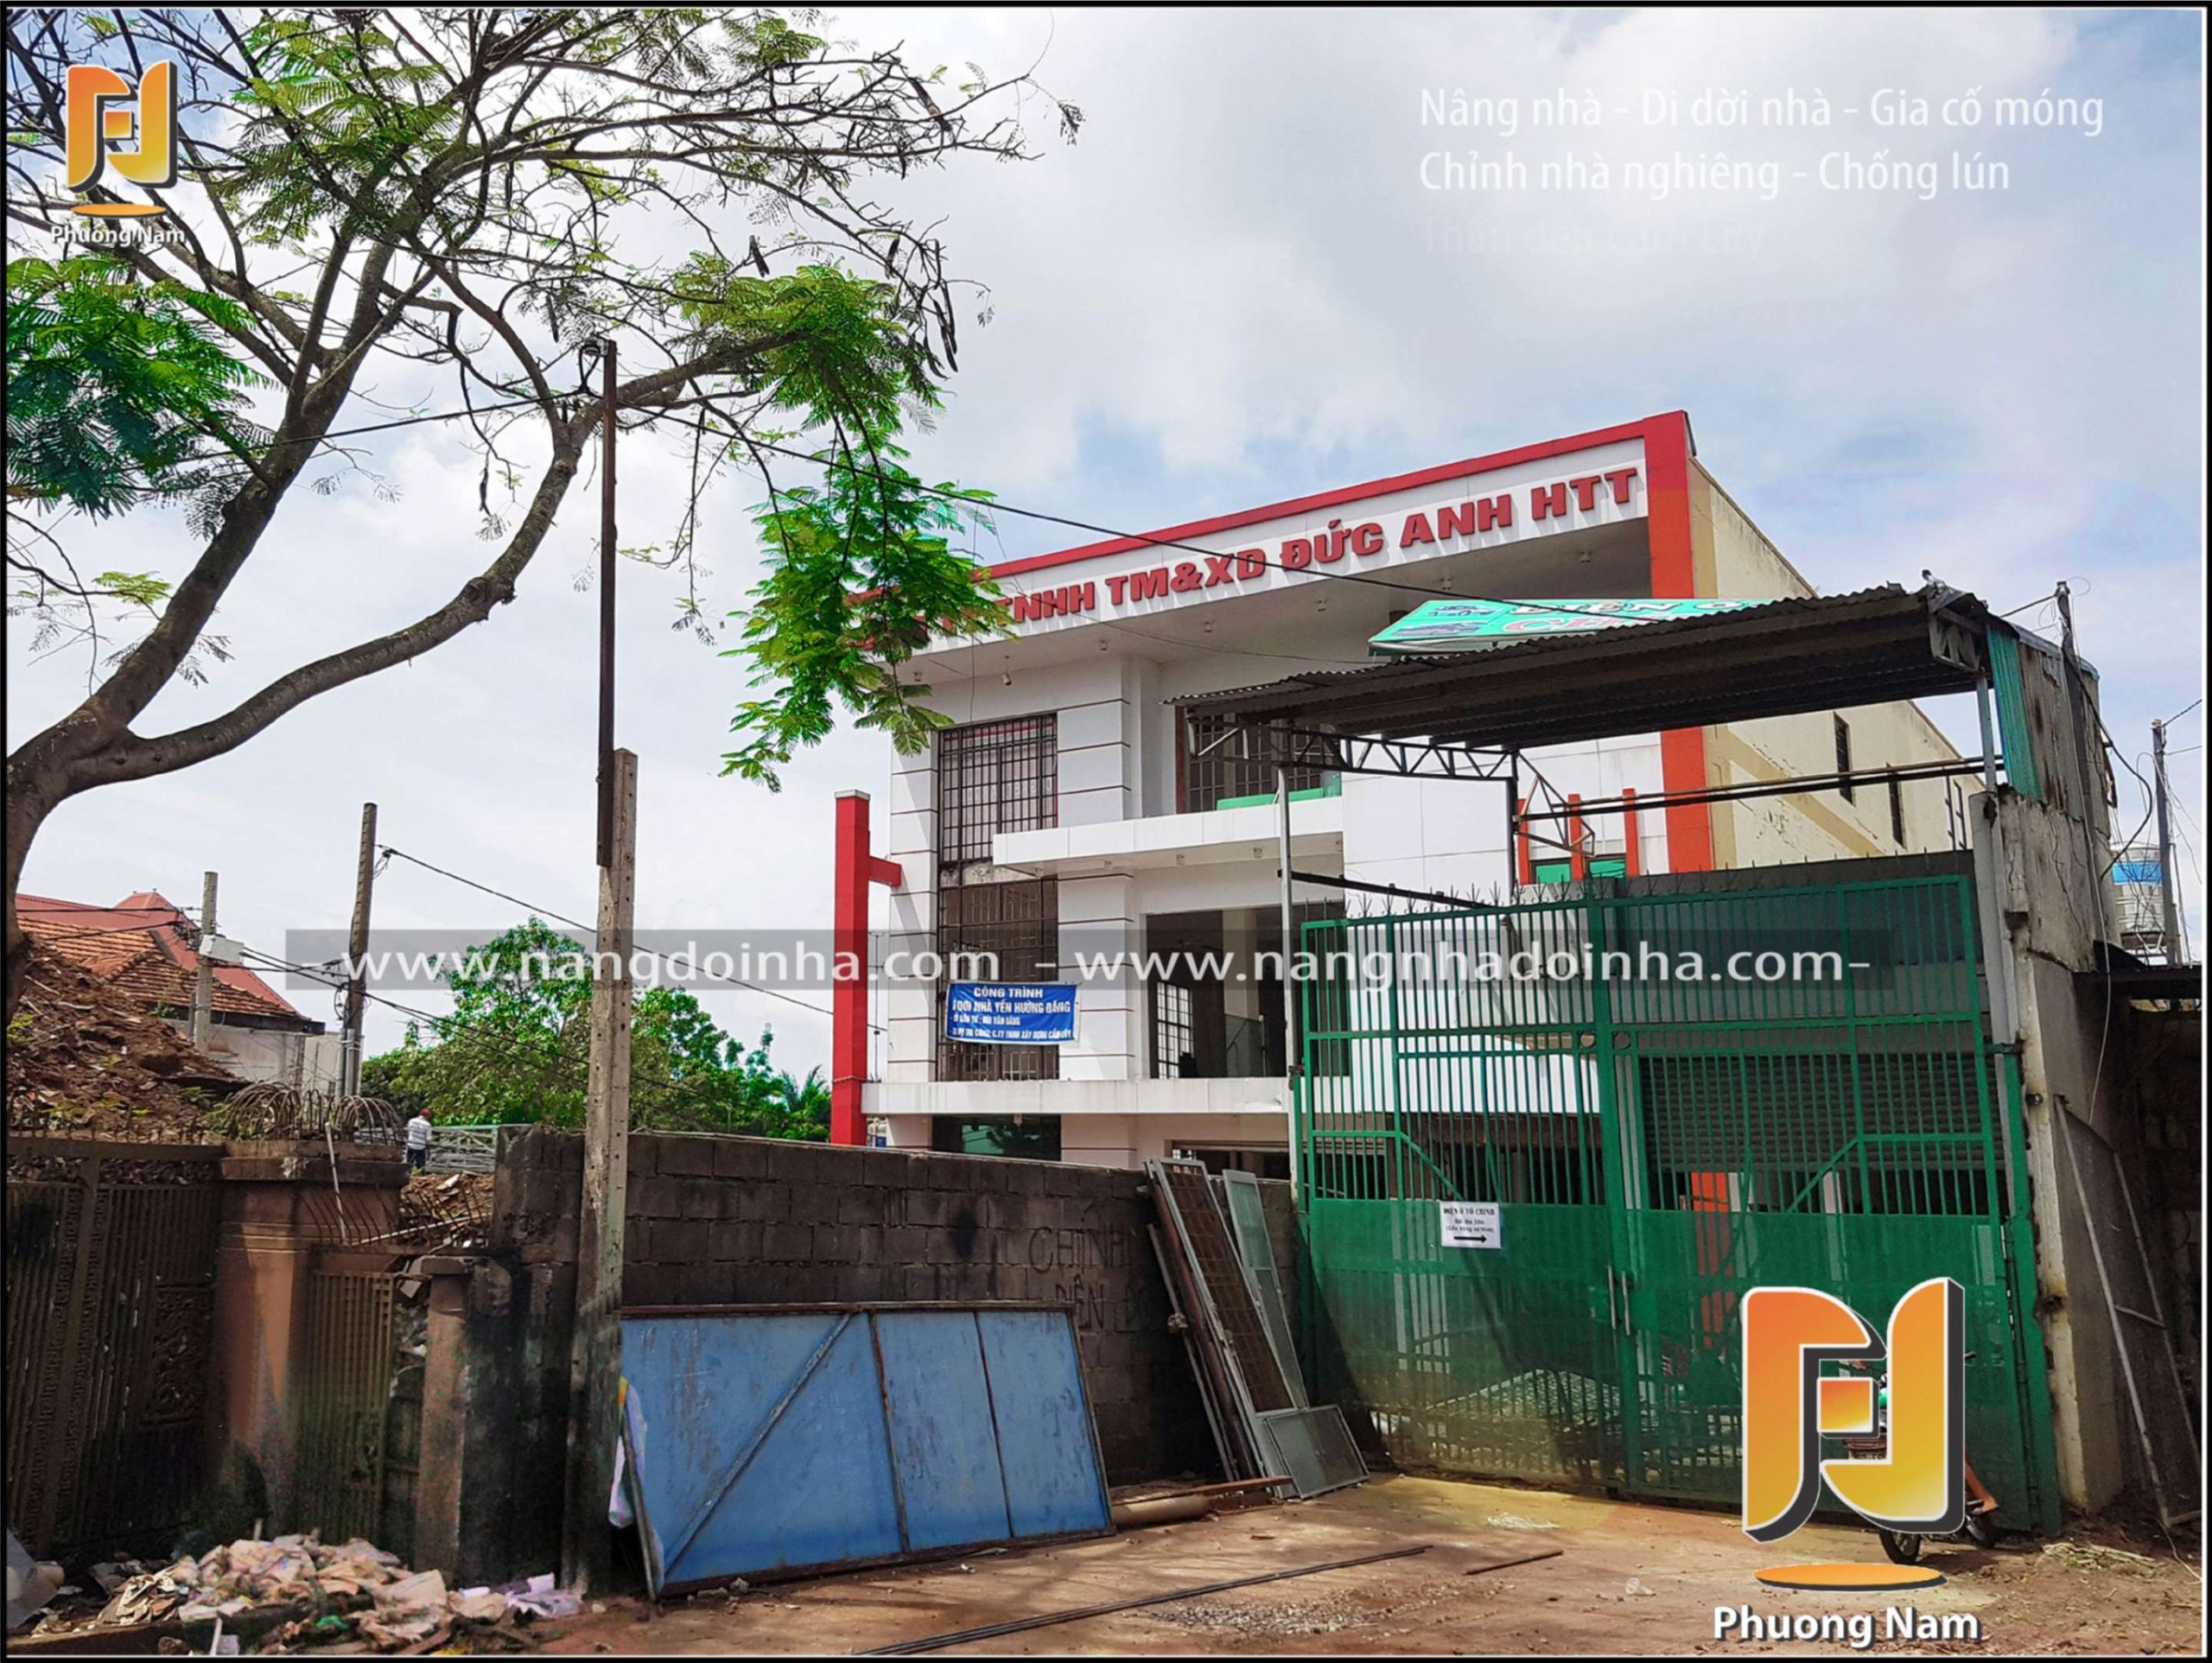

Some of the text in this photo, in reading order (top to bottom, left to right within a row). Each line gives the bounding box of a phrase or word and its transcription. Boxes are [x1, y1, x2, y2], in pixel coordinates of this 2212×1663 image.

[1105, 547, 1267, 606] TM&XD
[1280, 518, 1383, 571] ĐỨC
[1399, 493, 1512, 548] ANH
[1530, 467, 1638, 520] HTT
[973, 986, 1044, 999] CÔNG TRÌNH
